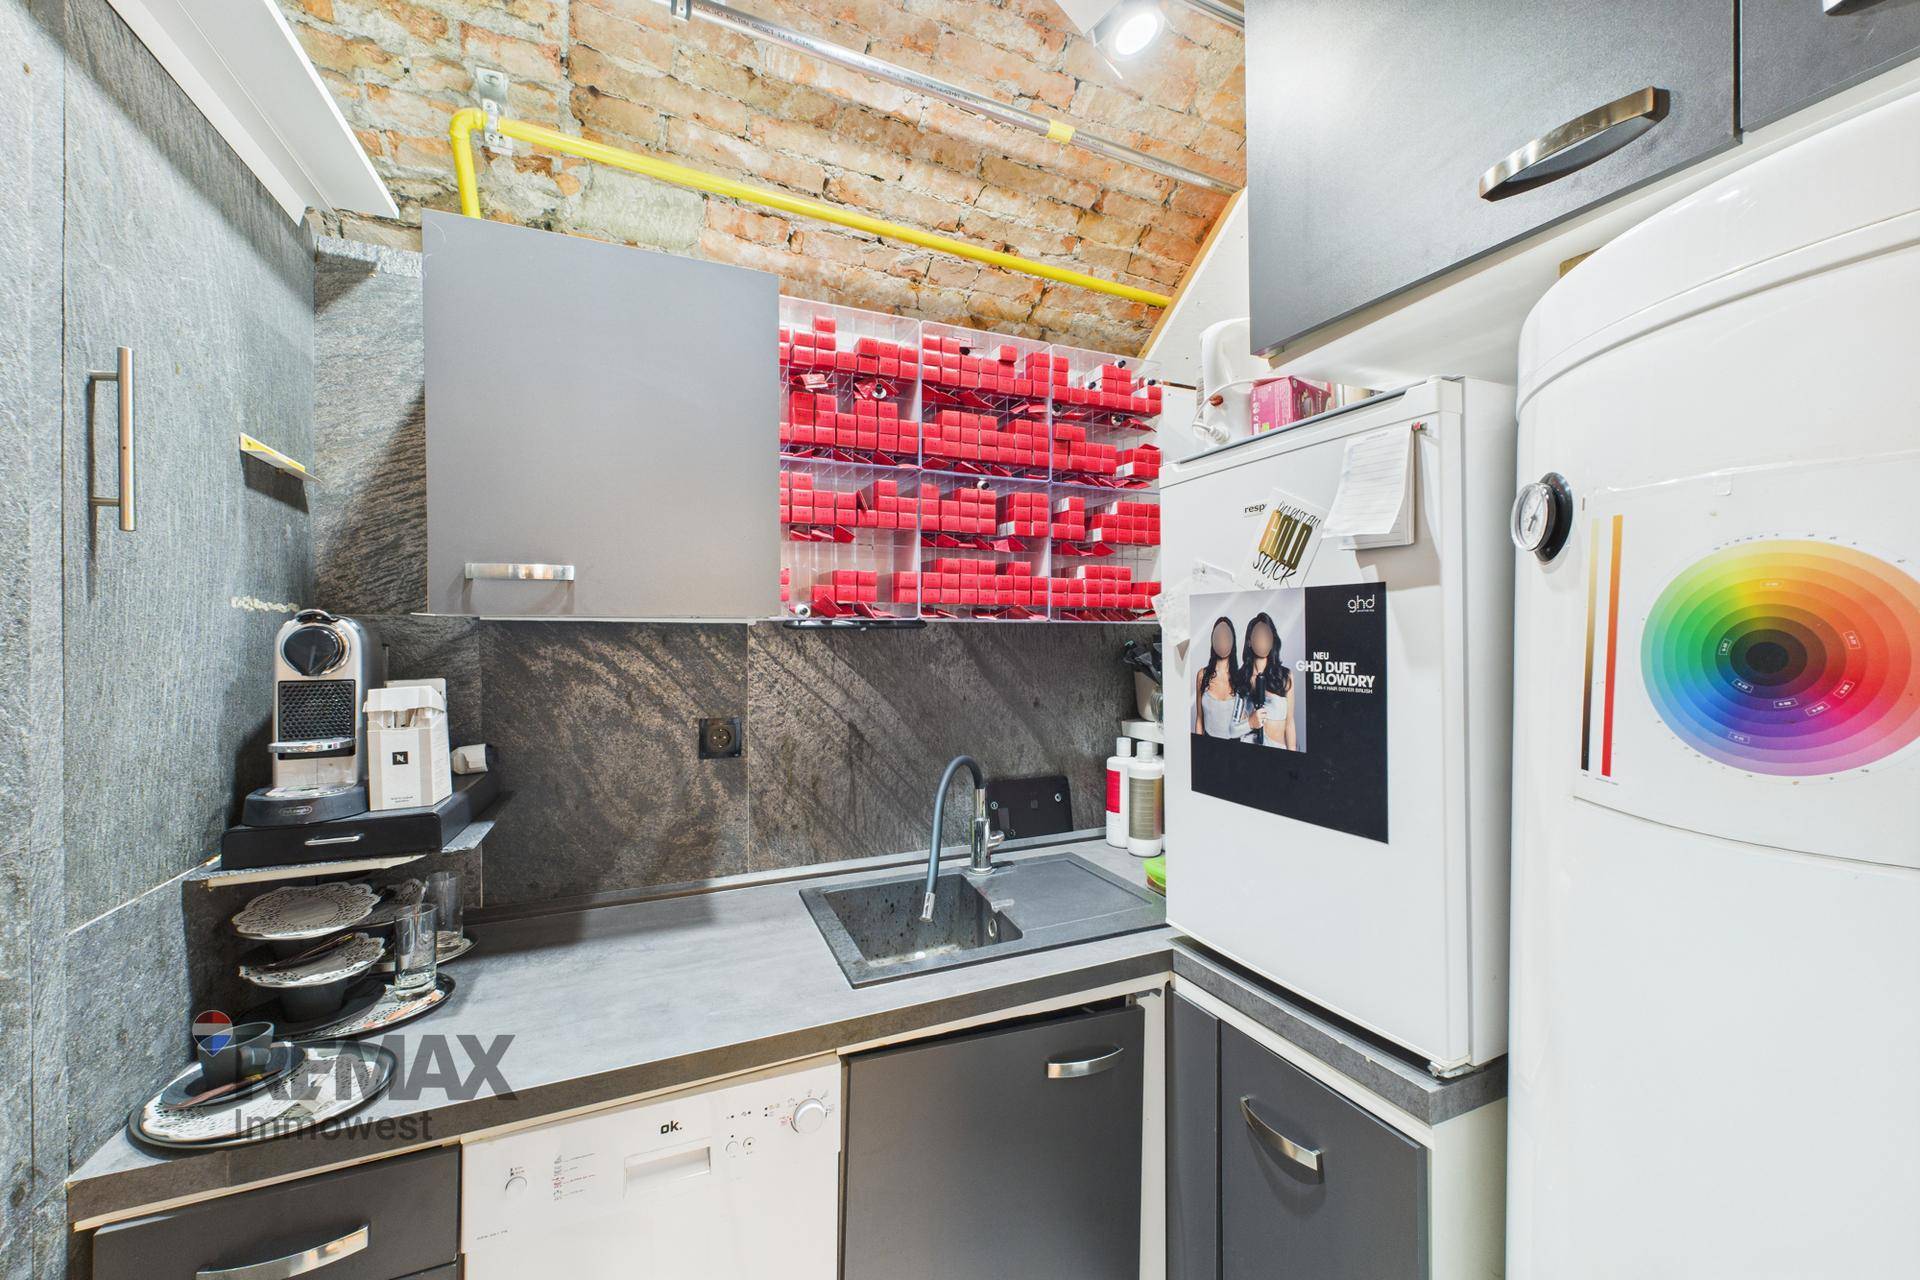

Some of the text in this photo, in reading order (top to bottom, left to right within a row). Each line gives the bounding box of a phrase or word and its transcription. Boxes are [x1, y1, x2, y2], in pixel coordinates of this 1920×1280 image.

[1347, 594, 1376, 613] ghd
[1313, 651, 1329, 660] NEU
[1295, 660, 1357, 674] GHD DUET
[1313, 673, 1376, 688] BLOWDRY
